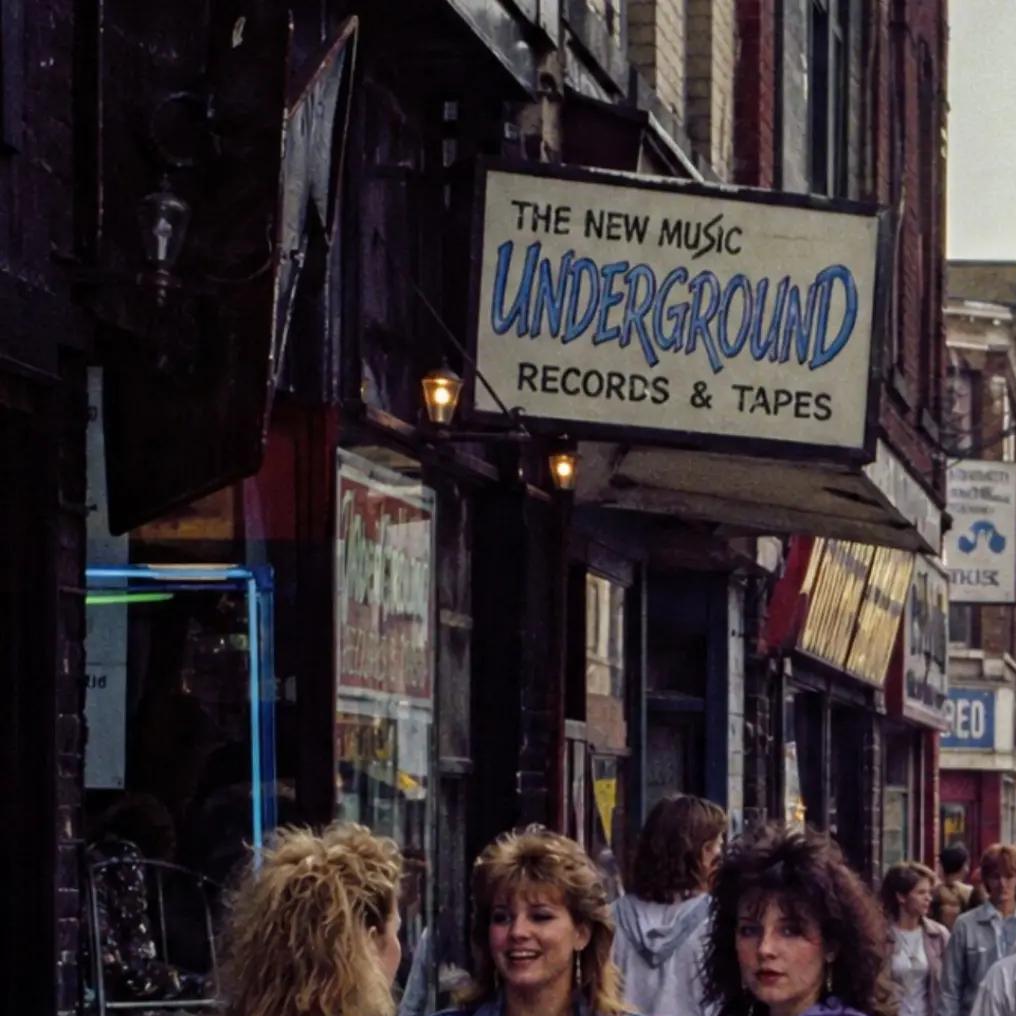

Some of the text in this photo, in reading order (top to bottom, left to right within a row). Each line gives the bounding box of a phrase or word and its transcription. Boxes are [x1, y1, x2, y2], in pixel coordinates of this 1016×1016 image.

[511, 200, 743, 260] THE NEW MUSIC
[490, 240, 859, 374] UNDERGROUND
[517, 362, 832, 421] RECORDS & TAPES
